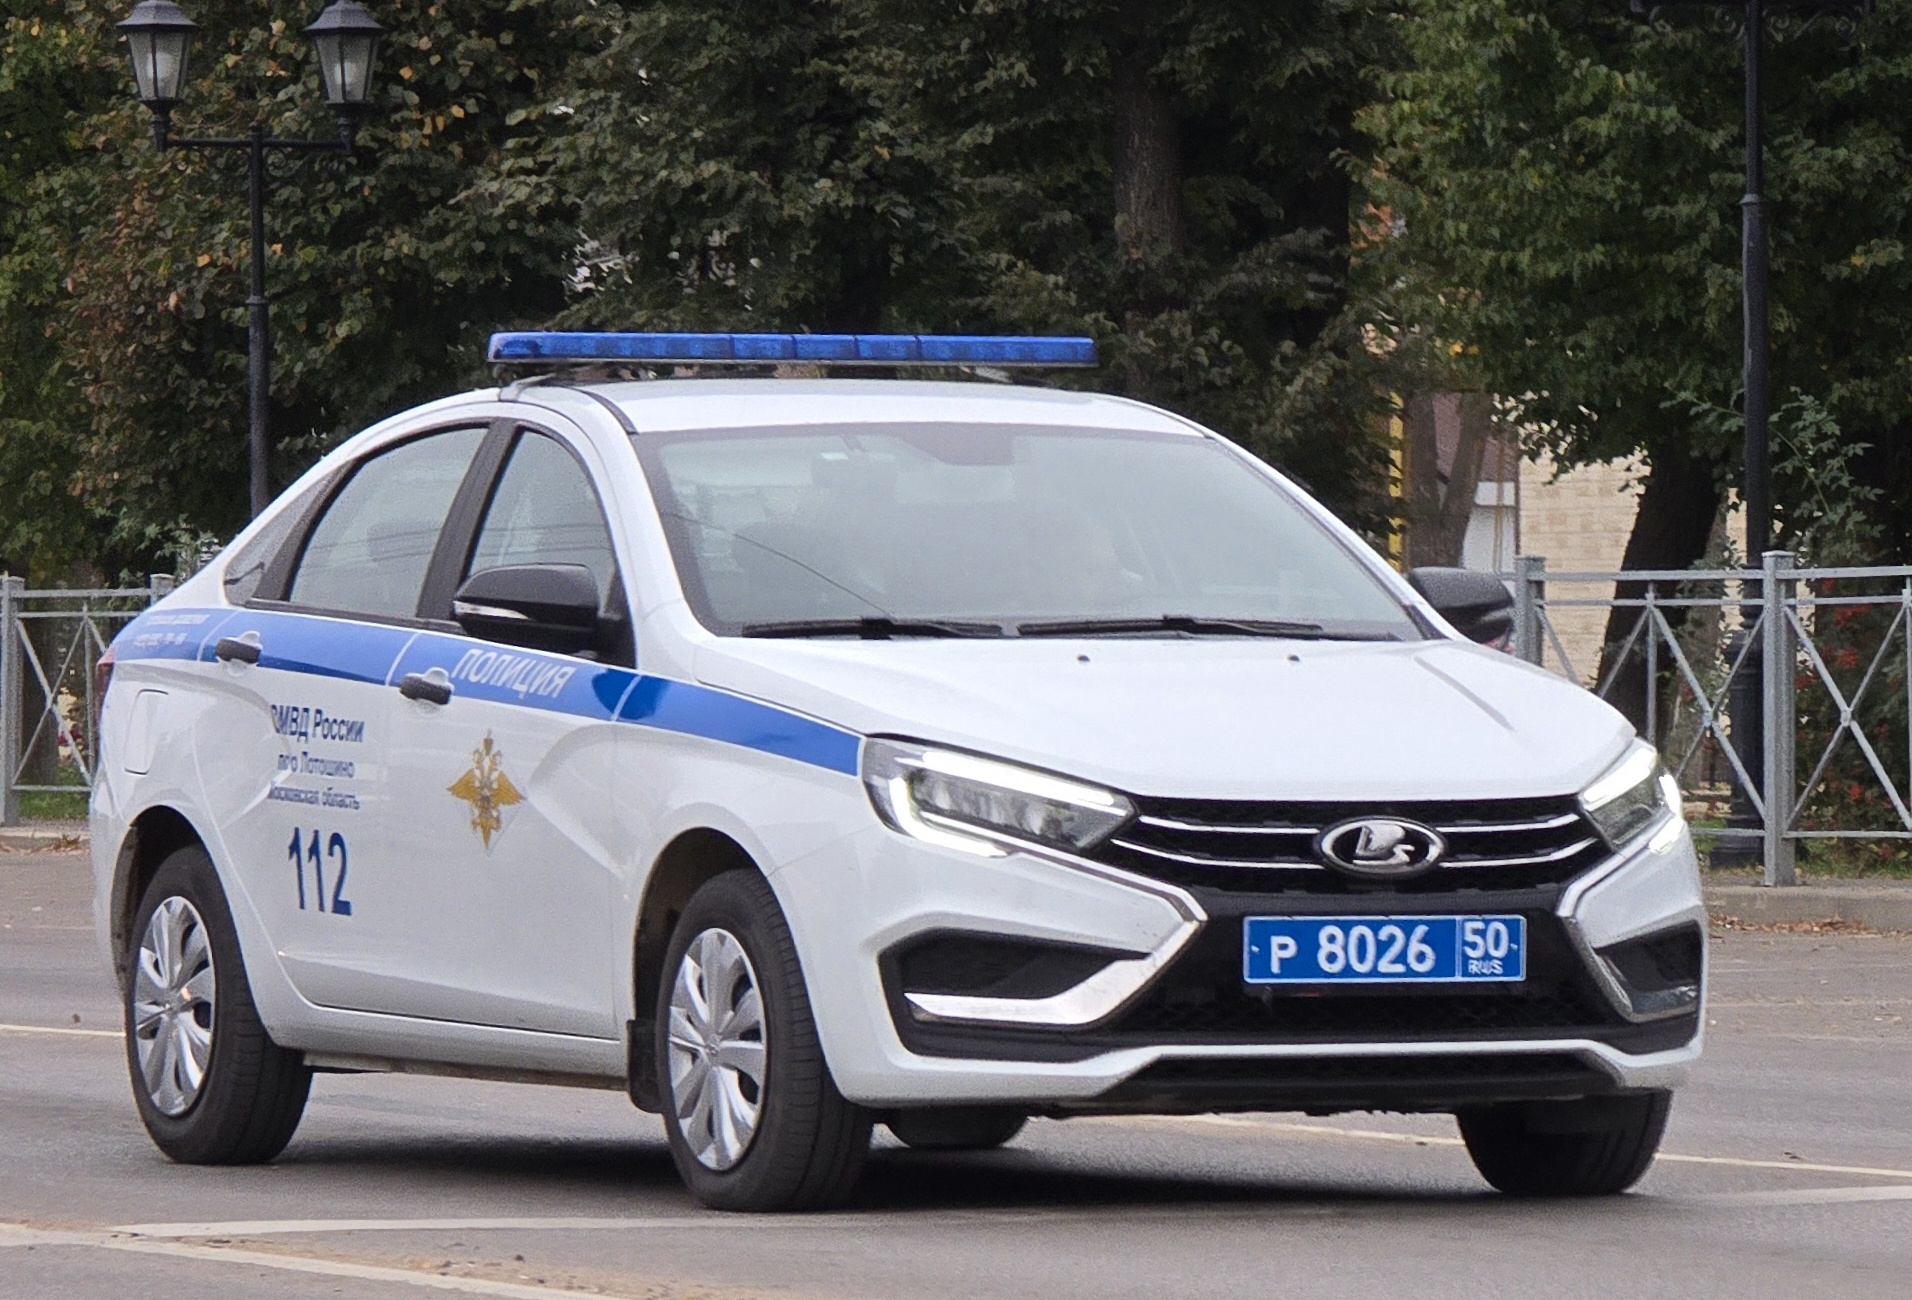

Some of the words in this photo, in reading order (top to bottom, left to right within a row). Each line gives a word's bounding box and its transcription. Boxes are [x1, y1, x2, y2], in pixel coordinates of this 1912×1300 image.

[450, 647, 577, 699] ПОЛИЦИЯ
[312, 708, 365, 743] России
[288, 826, 352, 916] 112
[1317, 924, 1436, 974] 8026
[1463, 921, 1509, 959] 50
[1468, 959, 1503, 975] RUS
